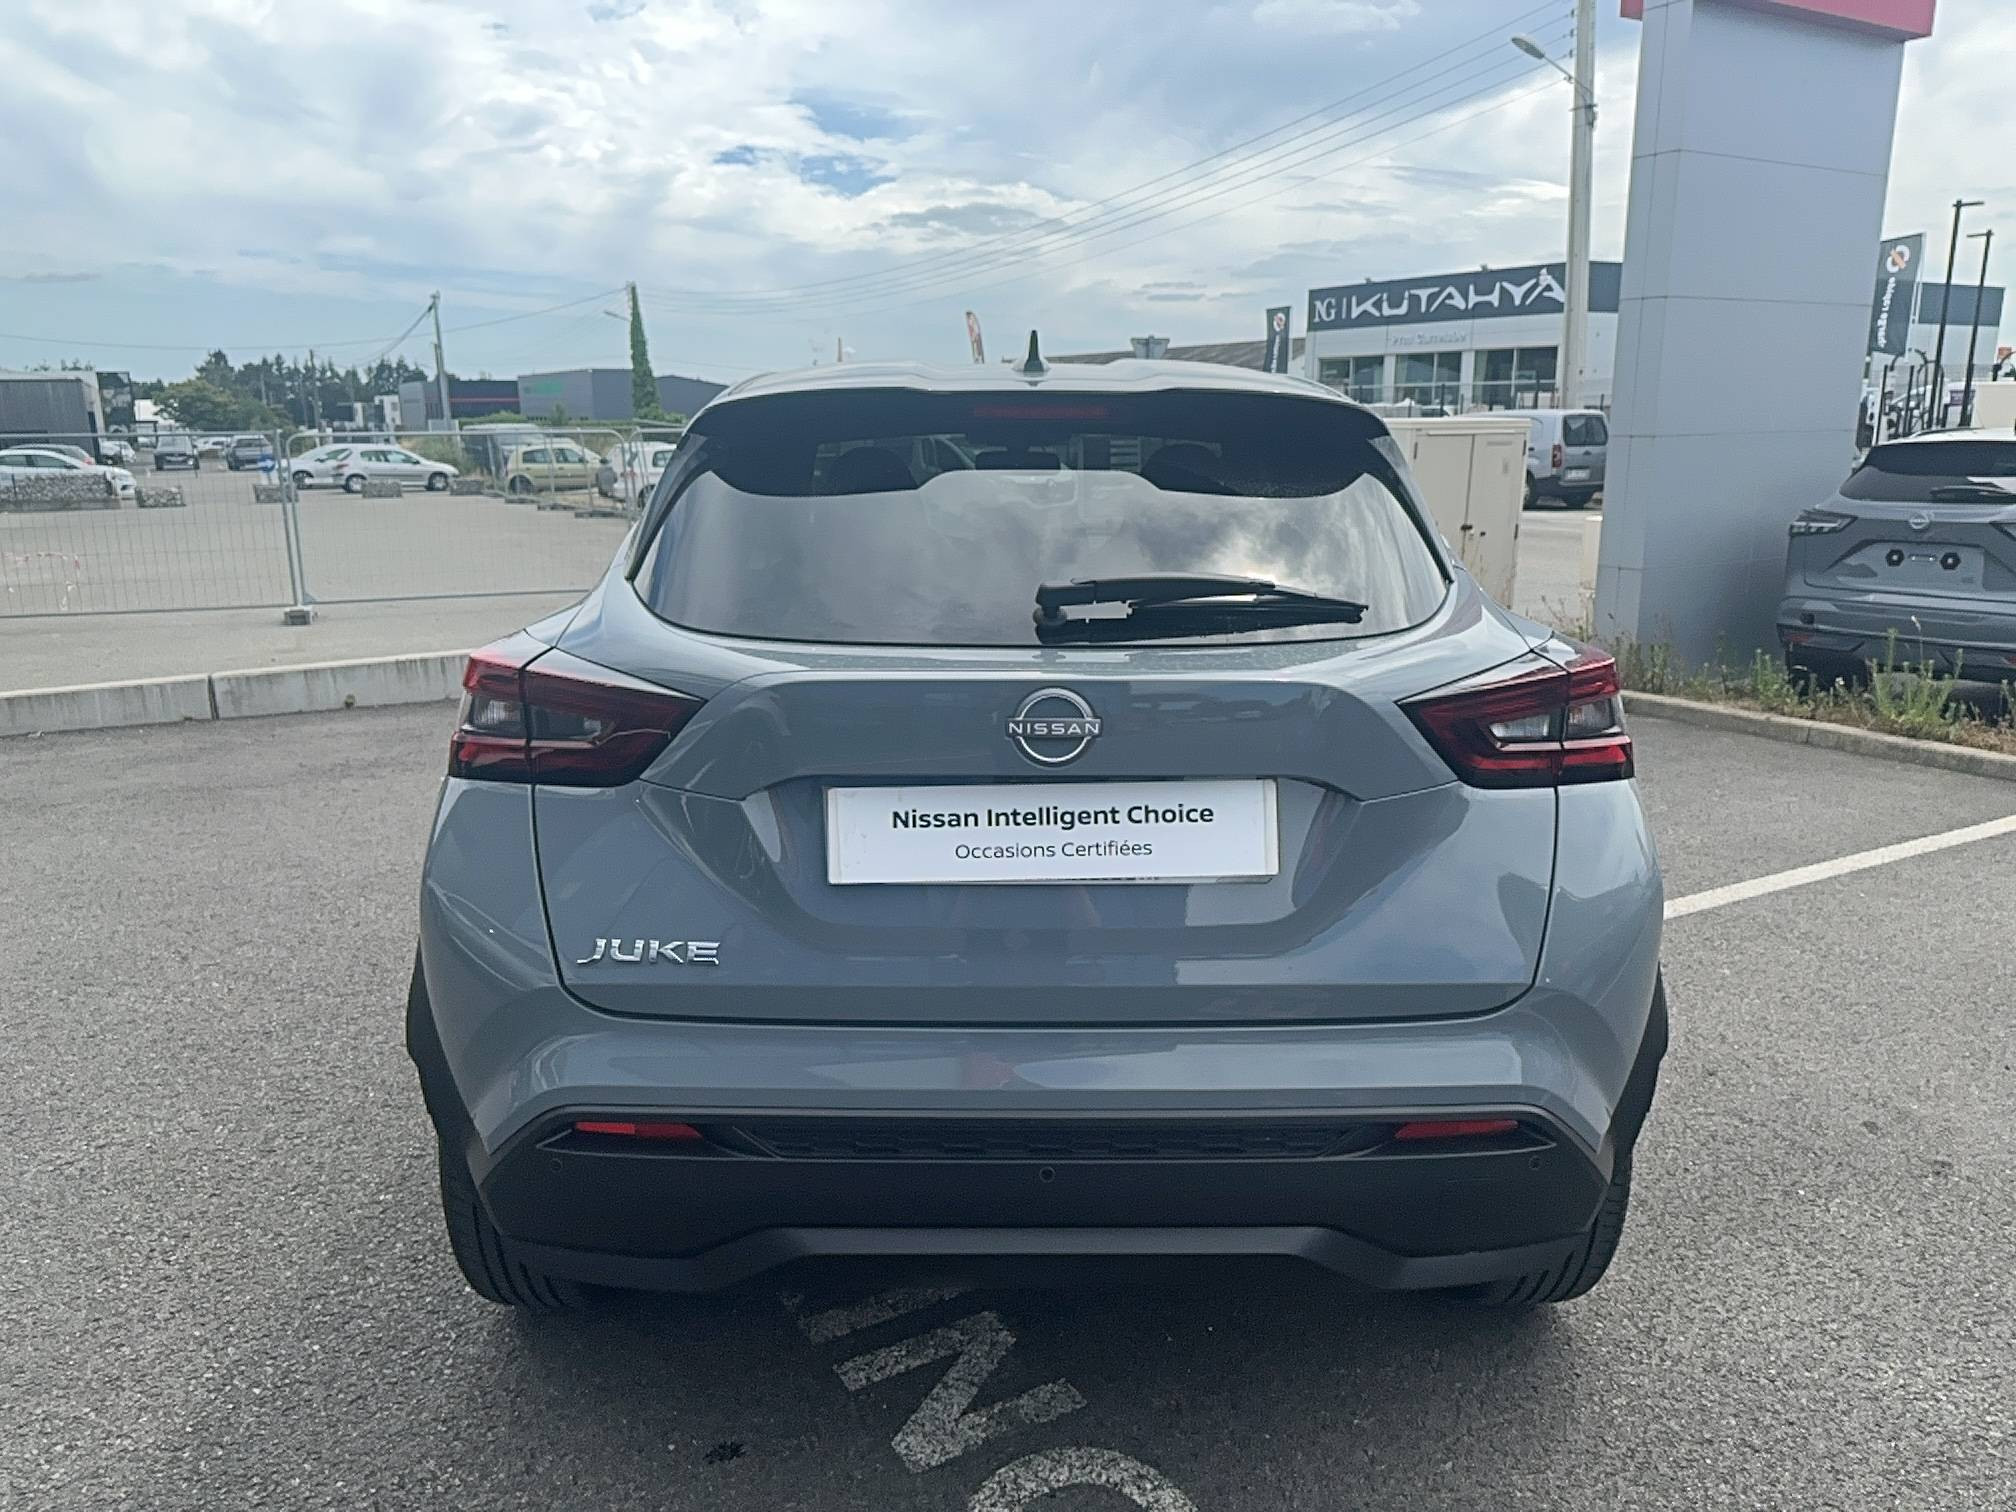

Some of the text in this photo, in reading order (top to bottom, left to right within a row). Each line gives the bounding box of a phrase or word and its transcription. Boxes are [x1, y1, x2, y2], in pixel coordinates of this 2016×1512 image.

[1008, 721, 1101, 736] NISSAN
[891, 803, 1214, 830] Nissan Intelligent Choice
[954, 839, 1153, 860] Occasions Certifiées
[576, 939, 720, 964] JUKE
